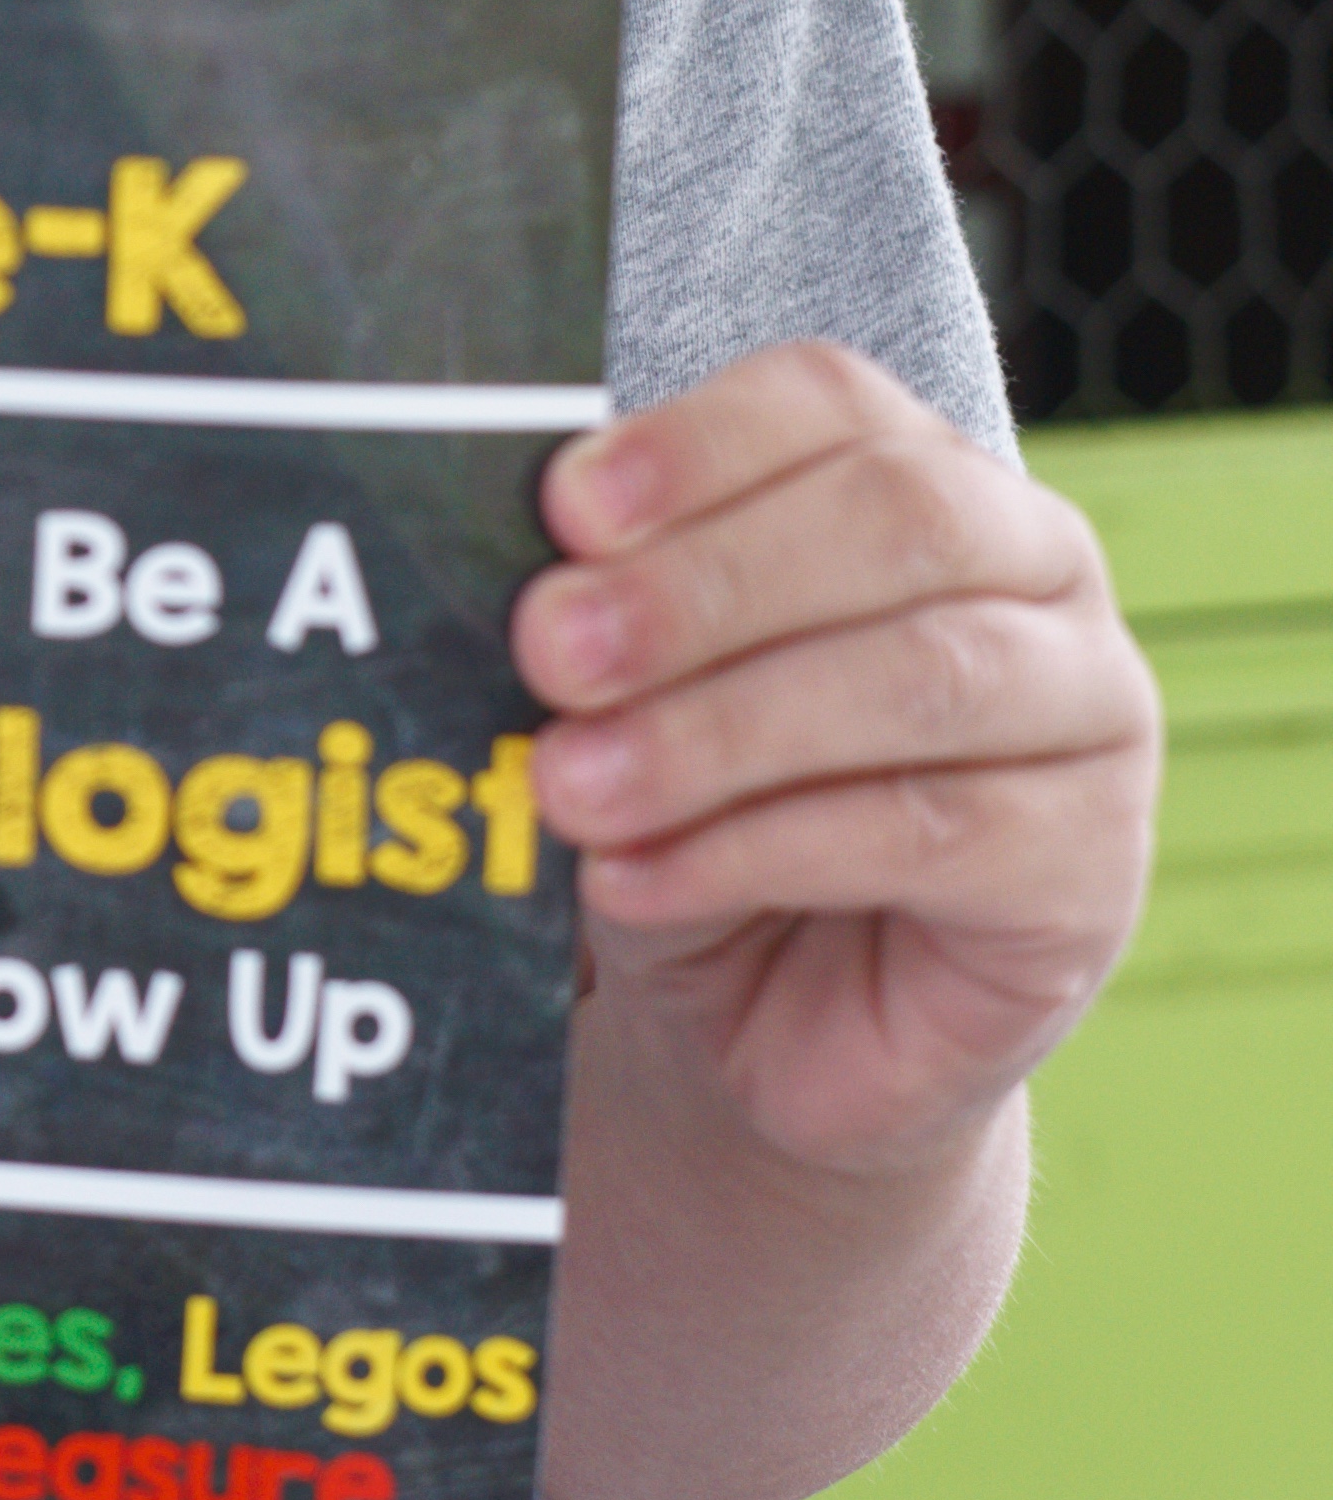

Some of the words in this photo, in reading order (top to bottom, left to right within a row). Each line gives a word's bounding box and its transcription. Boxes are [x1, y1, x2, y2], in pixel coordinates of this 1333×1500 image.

[30, 509, 222, 645] Be
[266, 522, 376, 654] A
[227, 948, 413, 1104] Up
[180, 1295, 536, 1436] Legos
